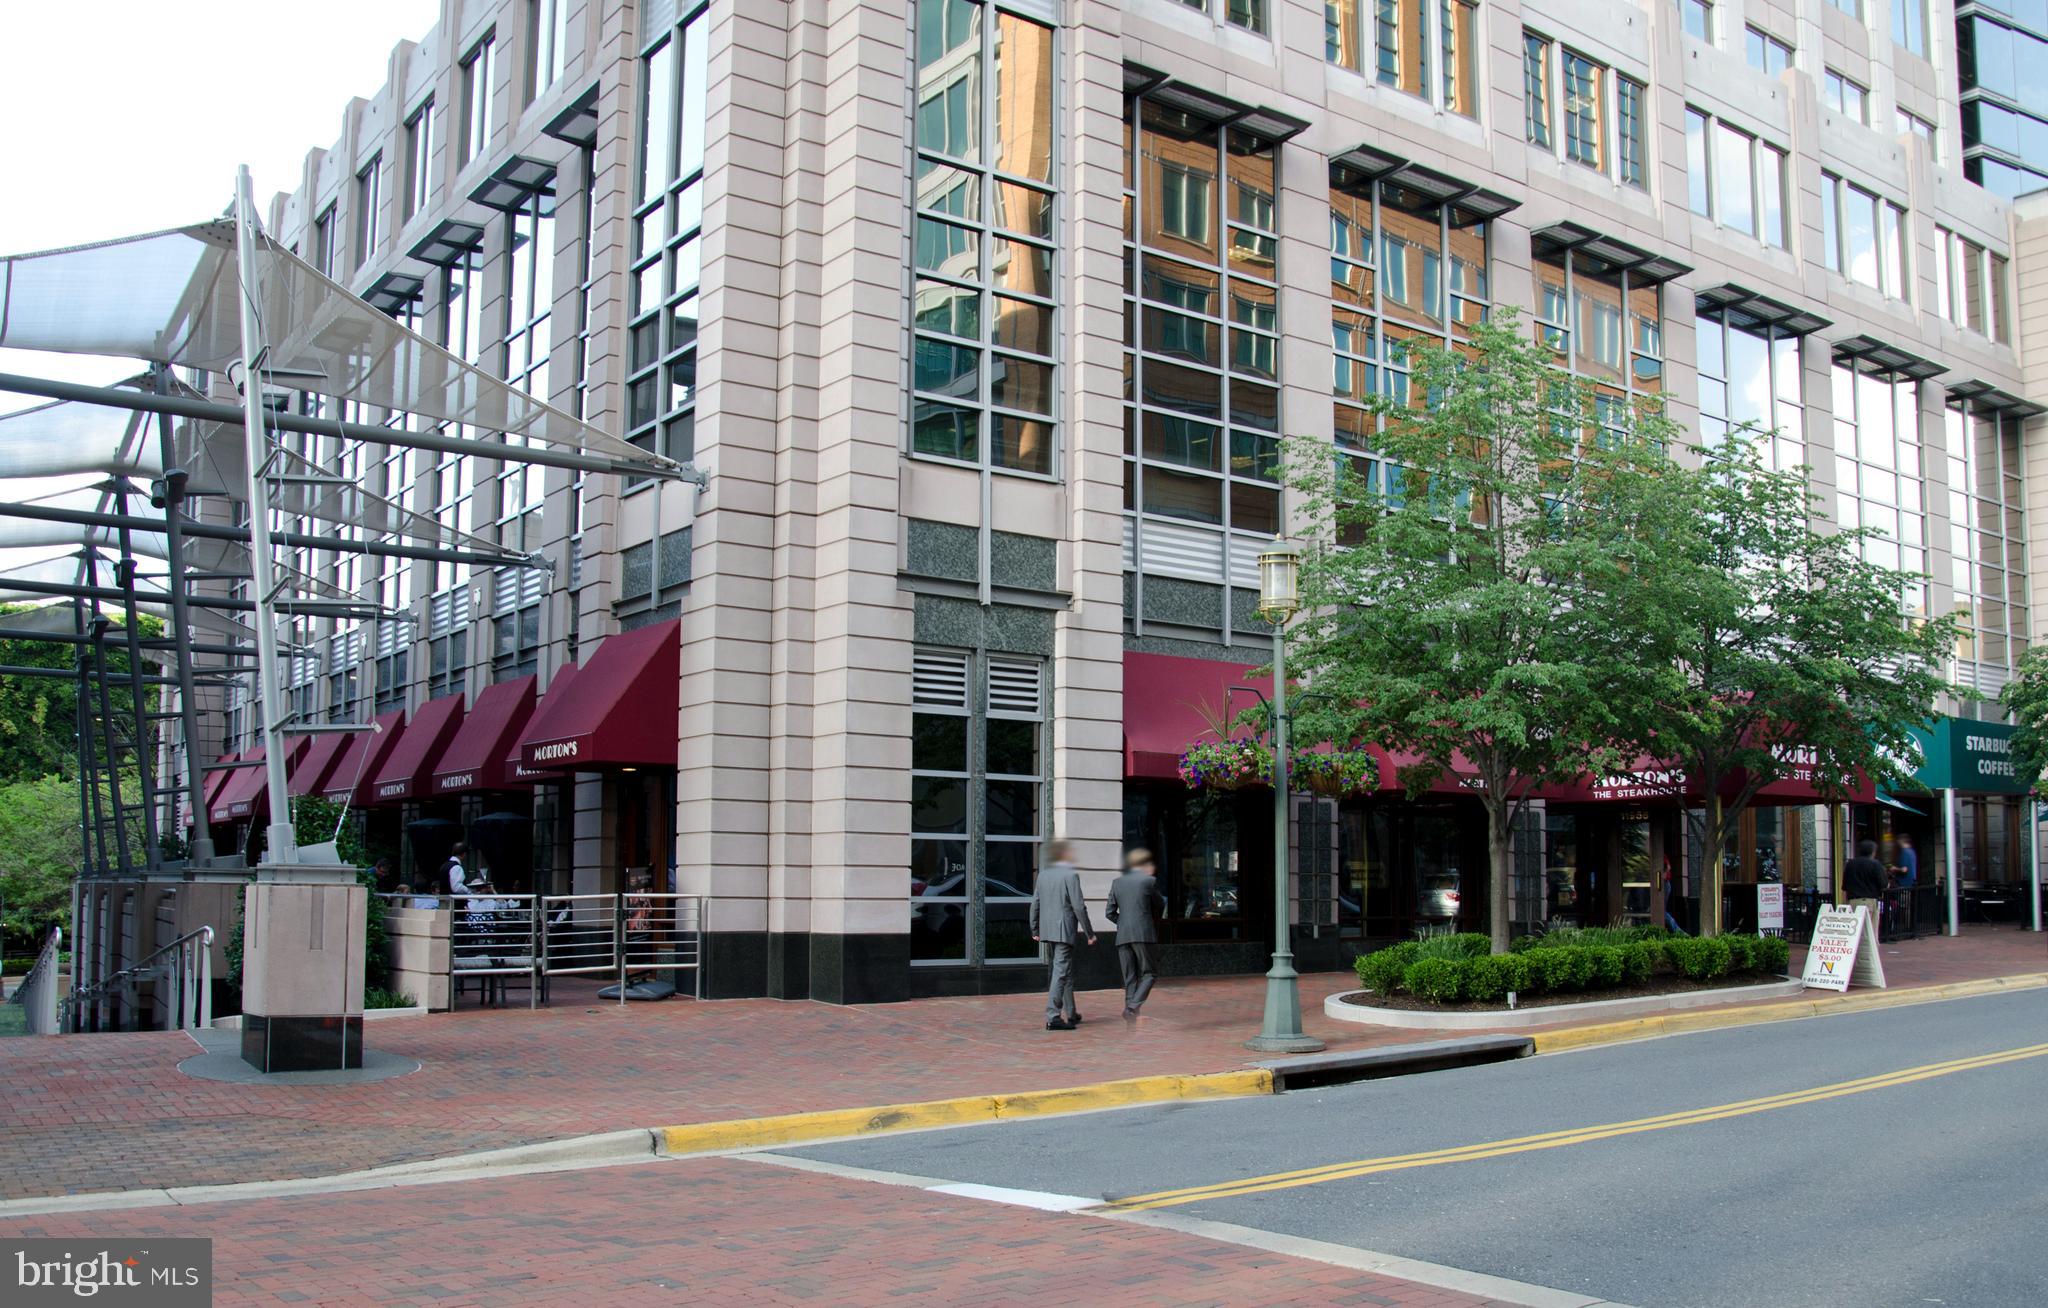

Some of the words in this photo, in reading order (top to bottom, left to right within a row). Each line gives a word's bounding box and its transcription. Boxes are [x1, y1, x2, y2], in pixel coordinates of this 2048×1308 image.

[534, 741, 578, 761] MORTON'S
[1966, 735, 2013, 754] STARBUC
[1977, 759, 2015, 777] COFFEE
[441, 773, 473, 789] MORTON'S
[379, 783, 405, 797] MORTON'S
[1593, 790, 1612, 799] THE
[1811, 945, 1853, 955] PARKING
[1820, 938, 1849, 947] VALET
